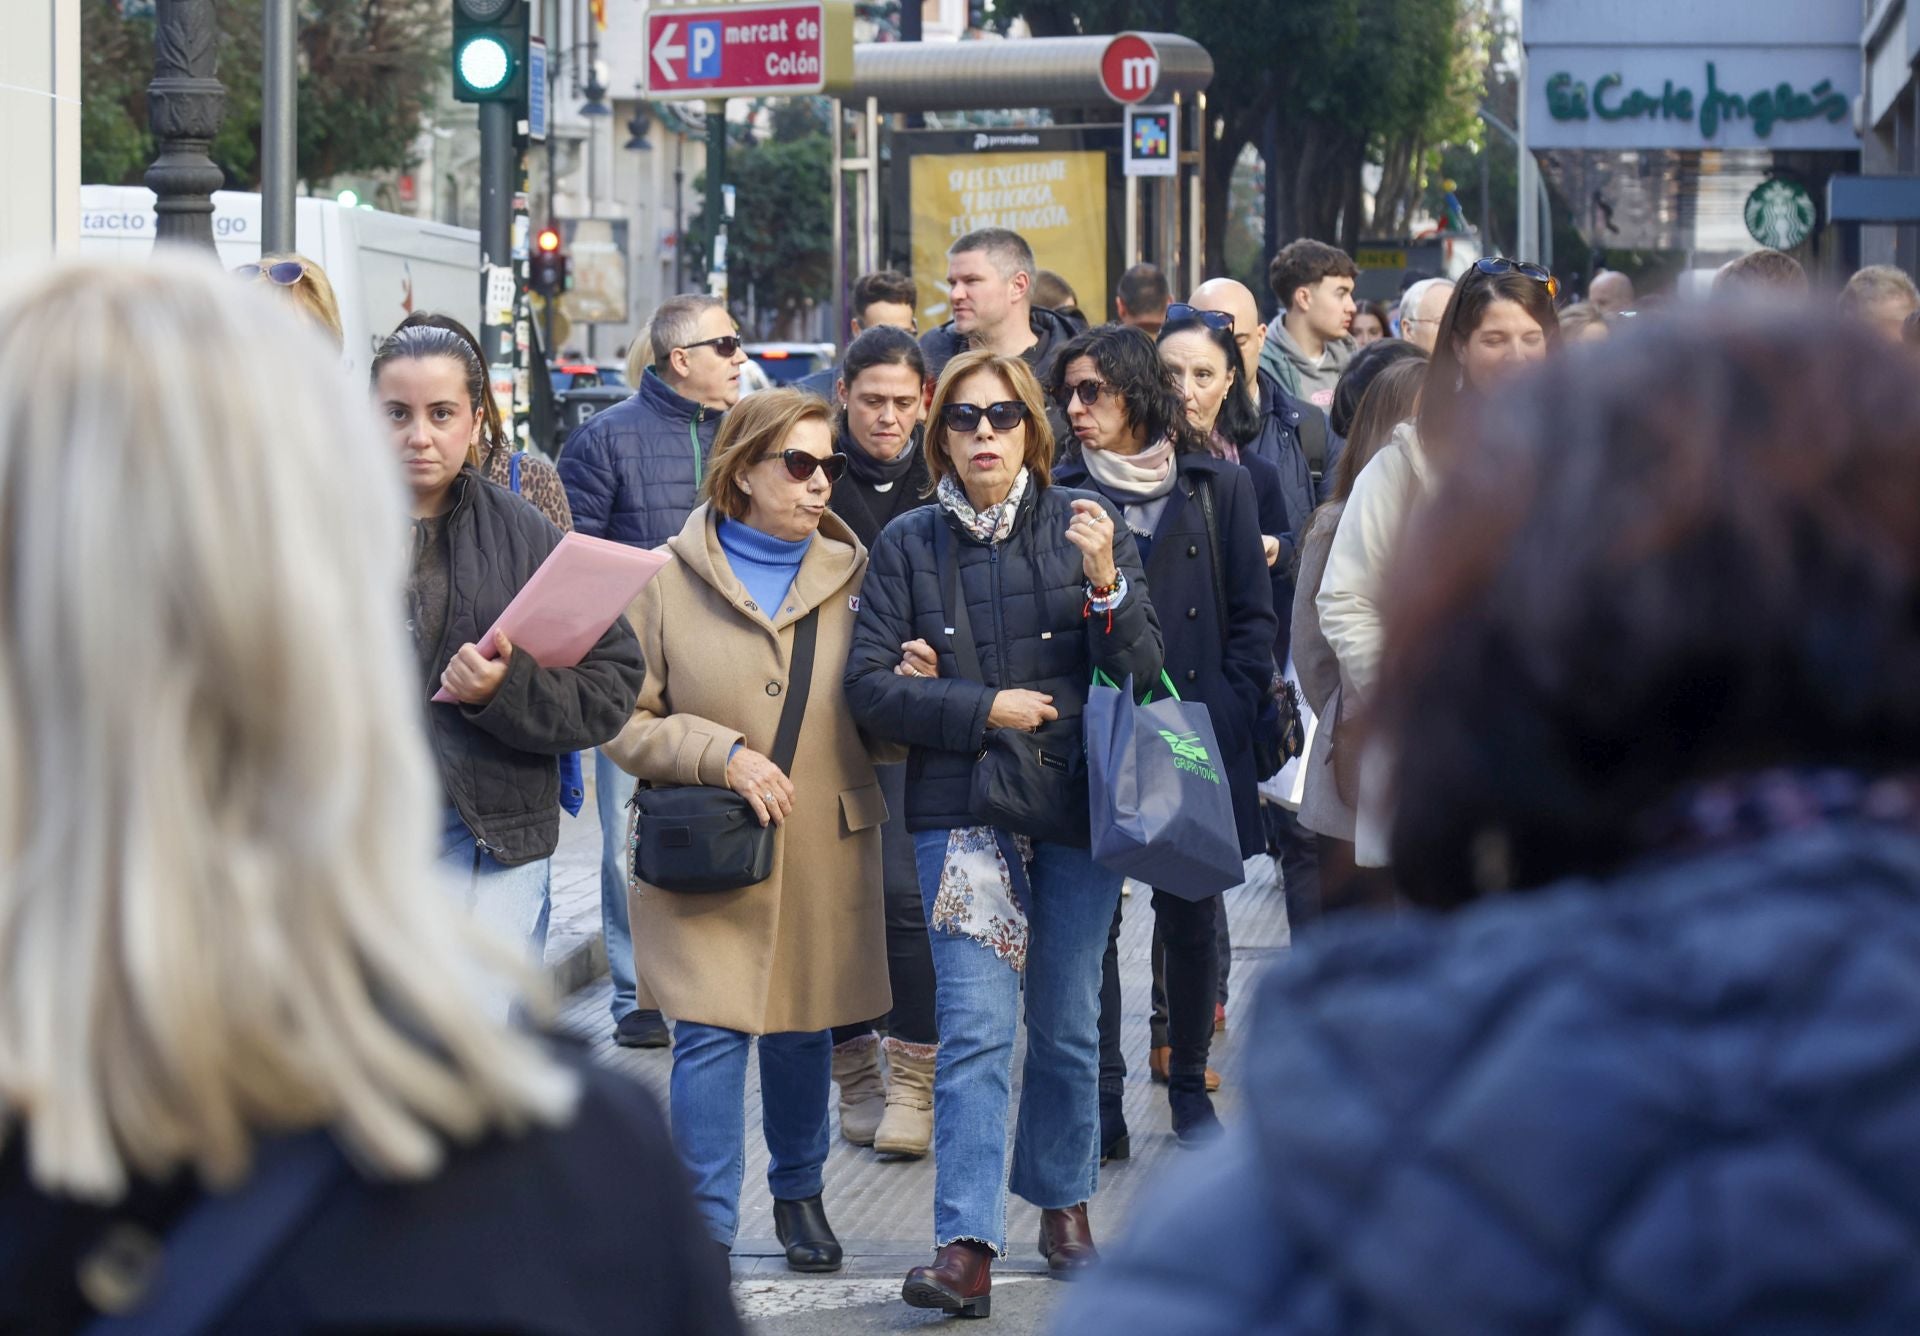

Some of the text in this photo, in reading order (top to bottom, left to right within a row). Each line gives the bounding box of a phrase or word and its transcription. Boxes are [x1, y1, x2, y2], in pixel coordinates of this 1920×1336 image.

[725, 18, 818, 44] mercat de
[693, 27, 715, 73] P
[765, 50, 818, 76] Colón
[1546, 60, 1848, 139] El Corte Inglés
[989, 133, 1039, 146] promedios
